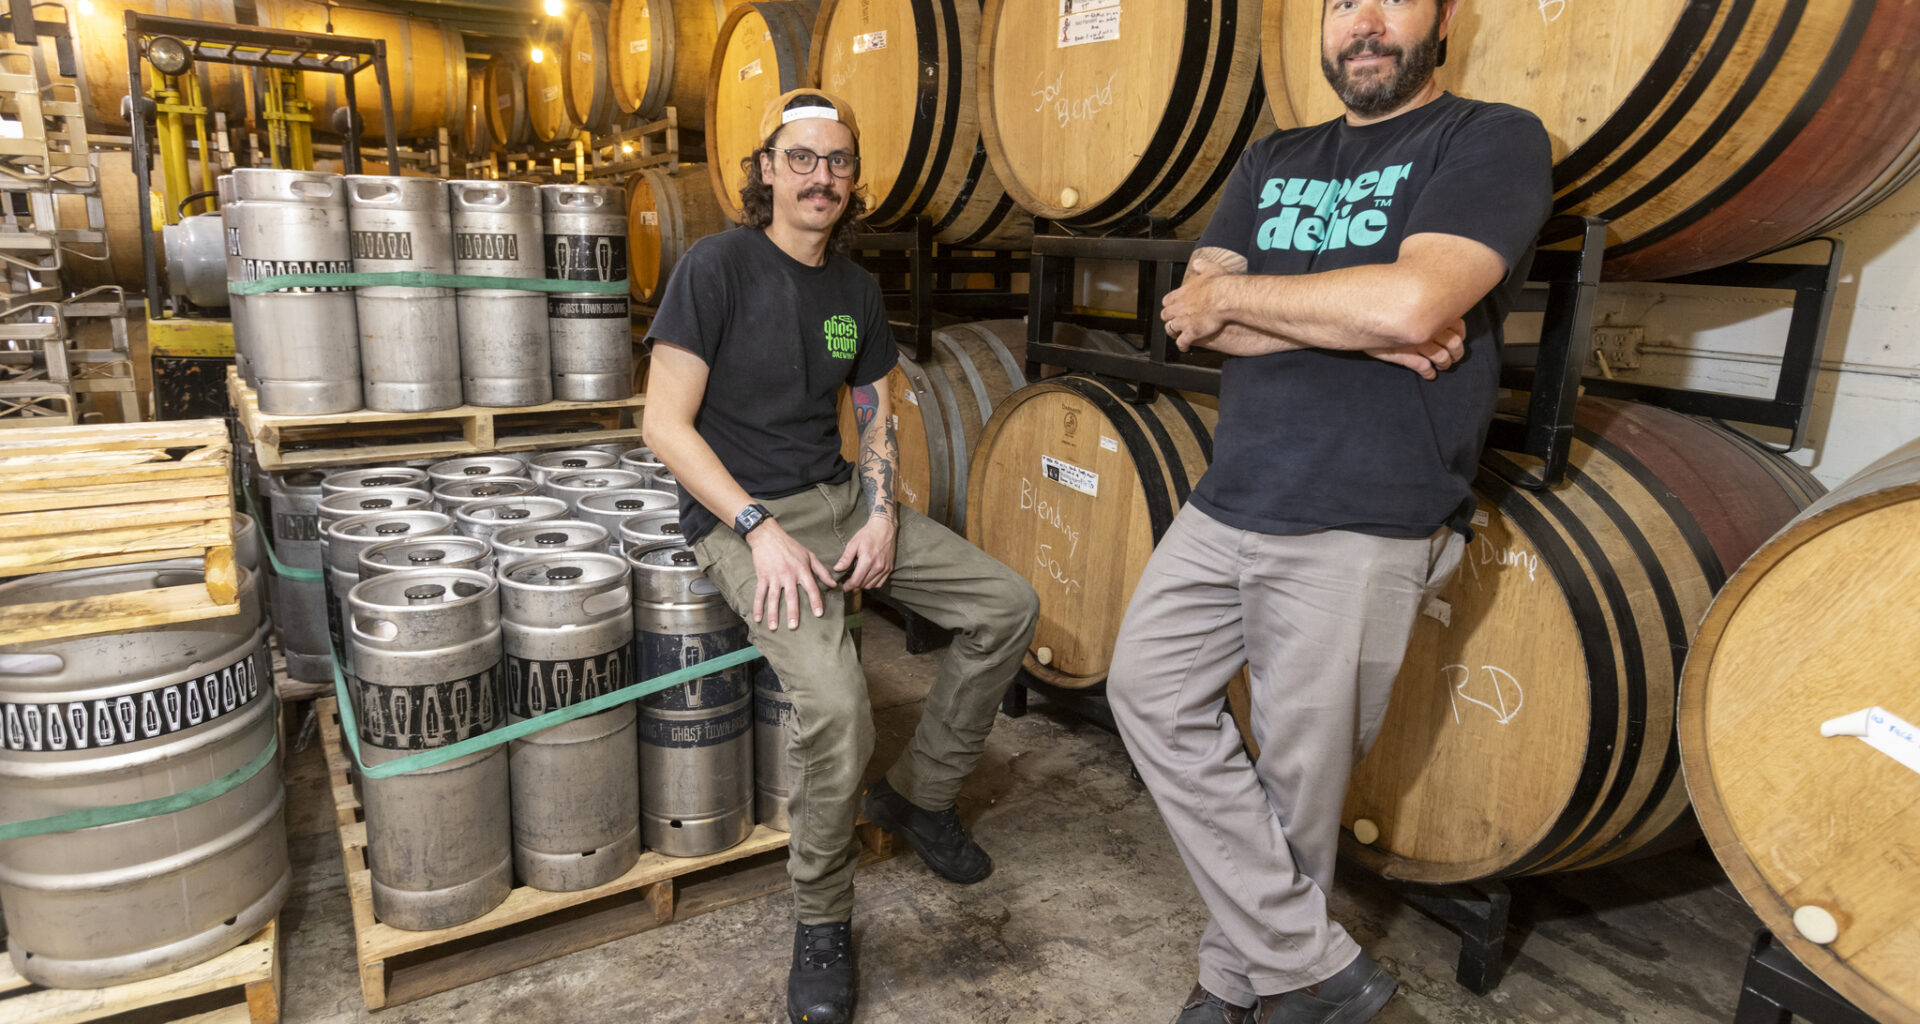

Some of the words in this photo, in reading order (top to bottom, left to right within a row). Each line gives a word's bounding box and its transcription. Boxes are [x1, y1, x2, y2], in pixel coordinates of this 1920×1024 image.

[1032, 71, 1064, 112] Sour
[1258, 162, 1413, 221] super
[1374, 199, 1392, 207] TM
[1257, 204, 1388, 255] delic
[581, 303, 601, 314] TOWN
[824, 315, 858, 340] ghost
[827, 336, 857, 354] town
[1020, 477, 1080, 558] Blending
[1036, 544, 1080, 595] Sour
[1479, 532, 1538, 581] Dump
[1441, 665, 1523, 725] RD
[671, 725, 700, 742] GHOST
[705, 718, 731, 739] TOWN
